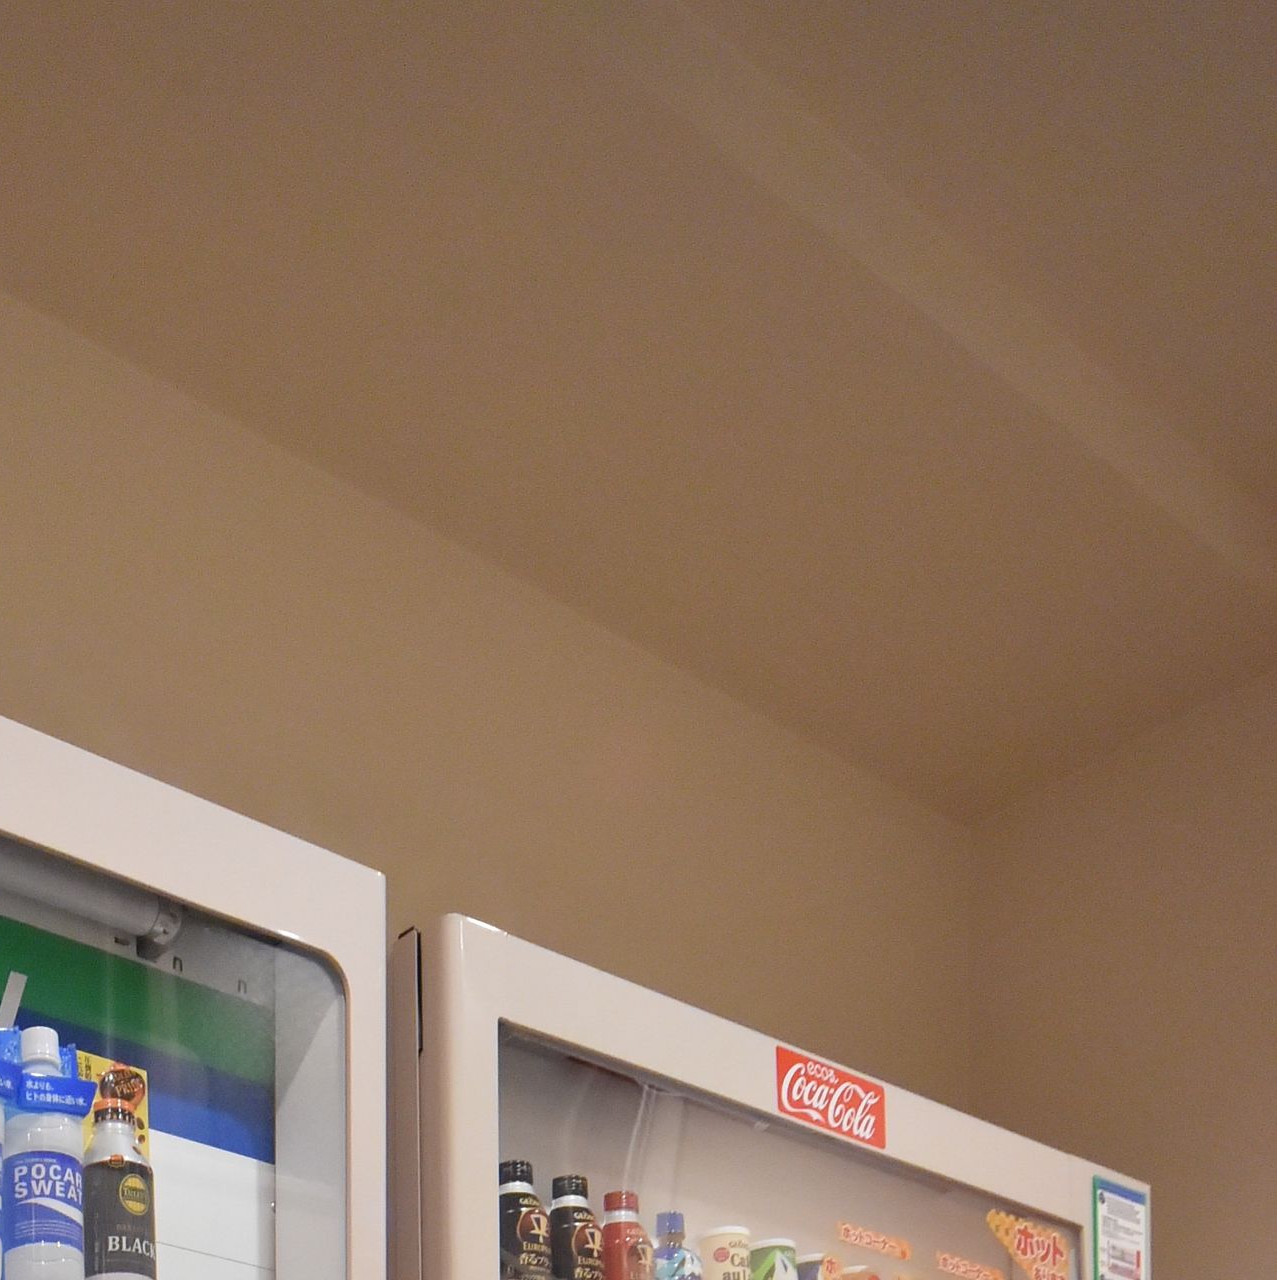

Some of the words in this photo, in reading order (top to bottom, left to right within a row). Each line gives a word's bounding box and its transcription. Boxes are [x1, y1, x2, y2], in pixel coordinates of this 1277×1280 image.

[107, 1235, 156, 1259] BLACK
[841, 1223, 898, 1251] ホットコーナー
[1015, 1225, 1065, 1265] ホット
